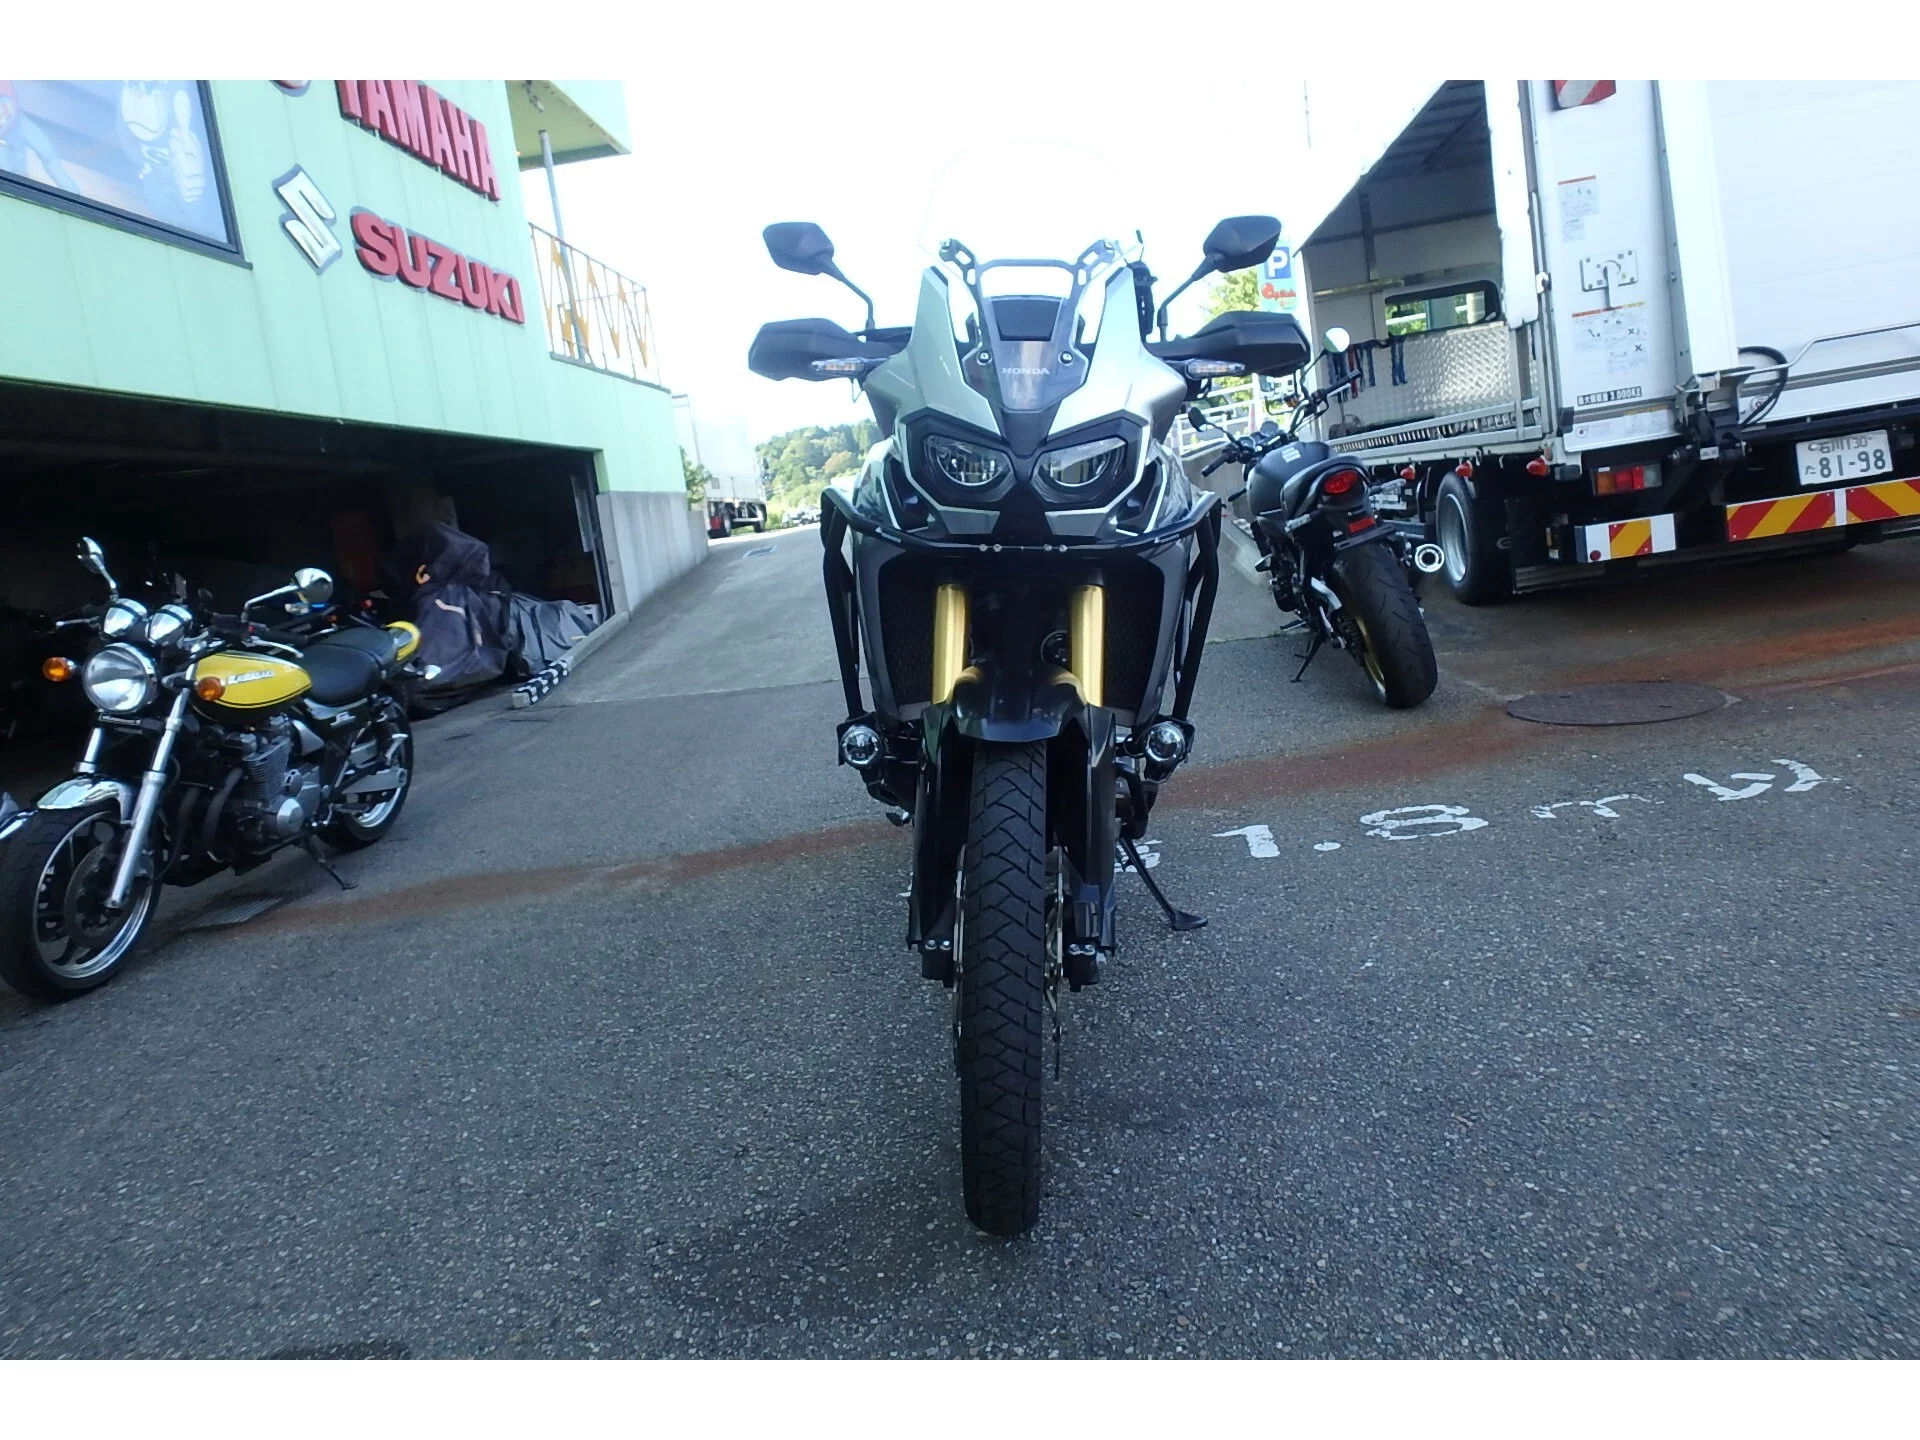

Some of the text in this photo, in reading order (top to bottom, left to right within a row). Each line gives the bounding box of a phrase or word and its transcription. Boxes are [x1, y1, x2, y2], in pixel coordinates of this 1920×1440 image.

[352, 212, 525, 324] SUZUKI
[1267, 249, 1288, 278] P
[1002, 367, 1050, 375] HONDA
[1819, 448, 1886, 478] 81-98
